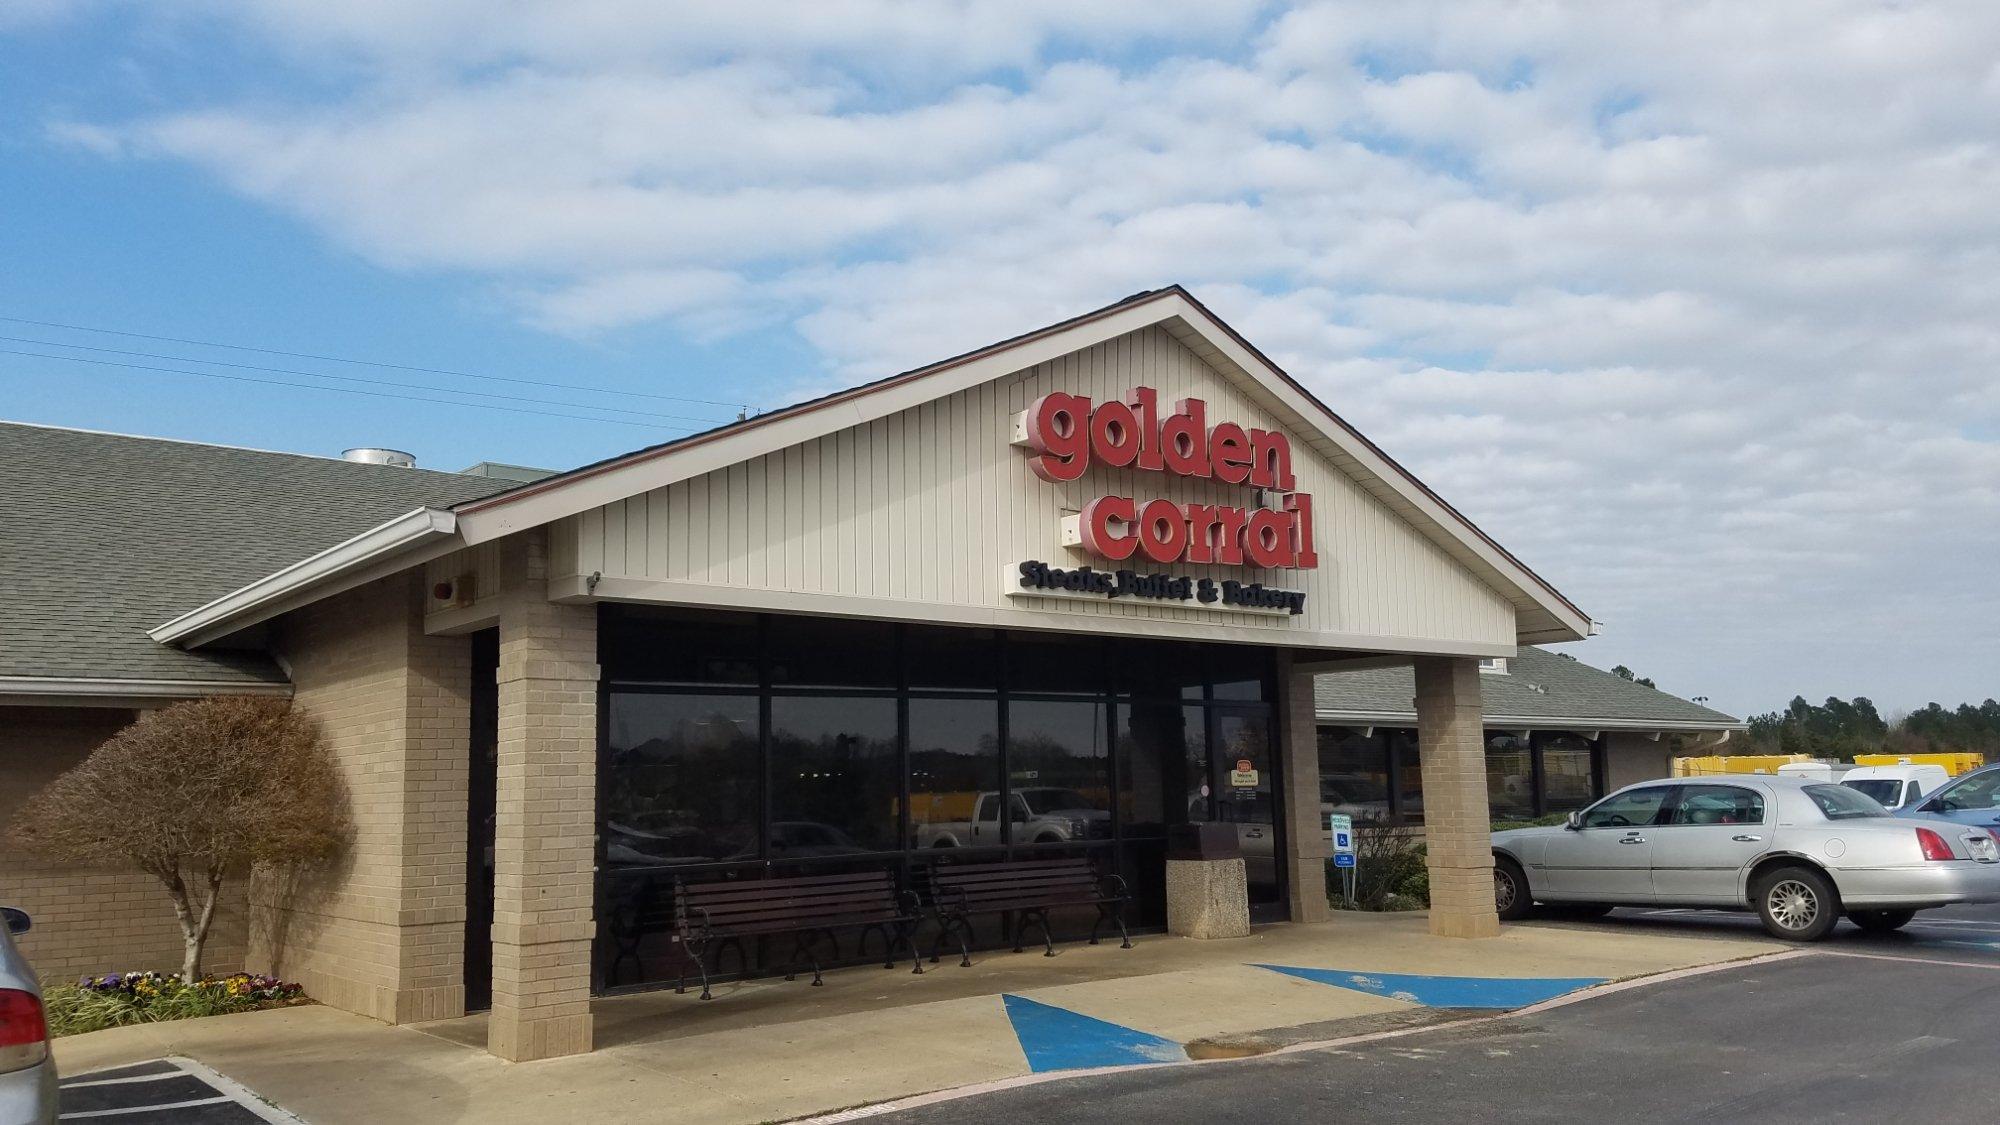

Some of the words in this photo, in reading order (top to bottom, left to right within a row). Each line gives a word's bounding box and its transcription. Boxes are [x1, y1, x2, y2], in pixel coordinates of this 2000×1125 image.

[1028, 386, 1296, 492] golden
[1080, 493, 1318, 570] corral
[1116, 569, 1193, 600] Buffet
[1197, 578, 1218, 603] &
[1221, 580, 1306, 615] Bakery
